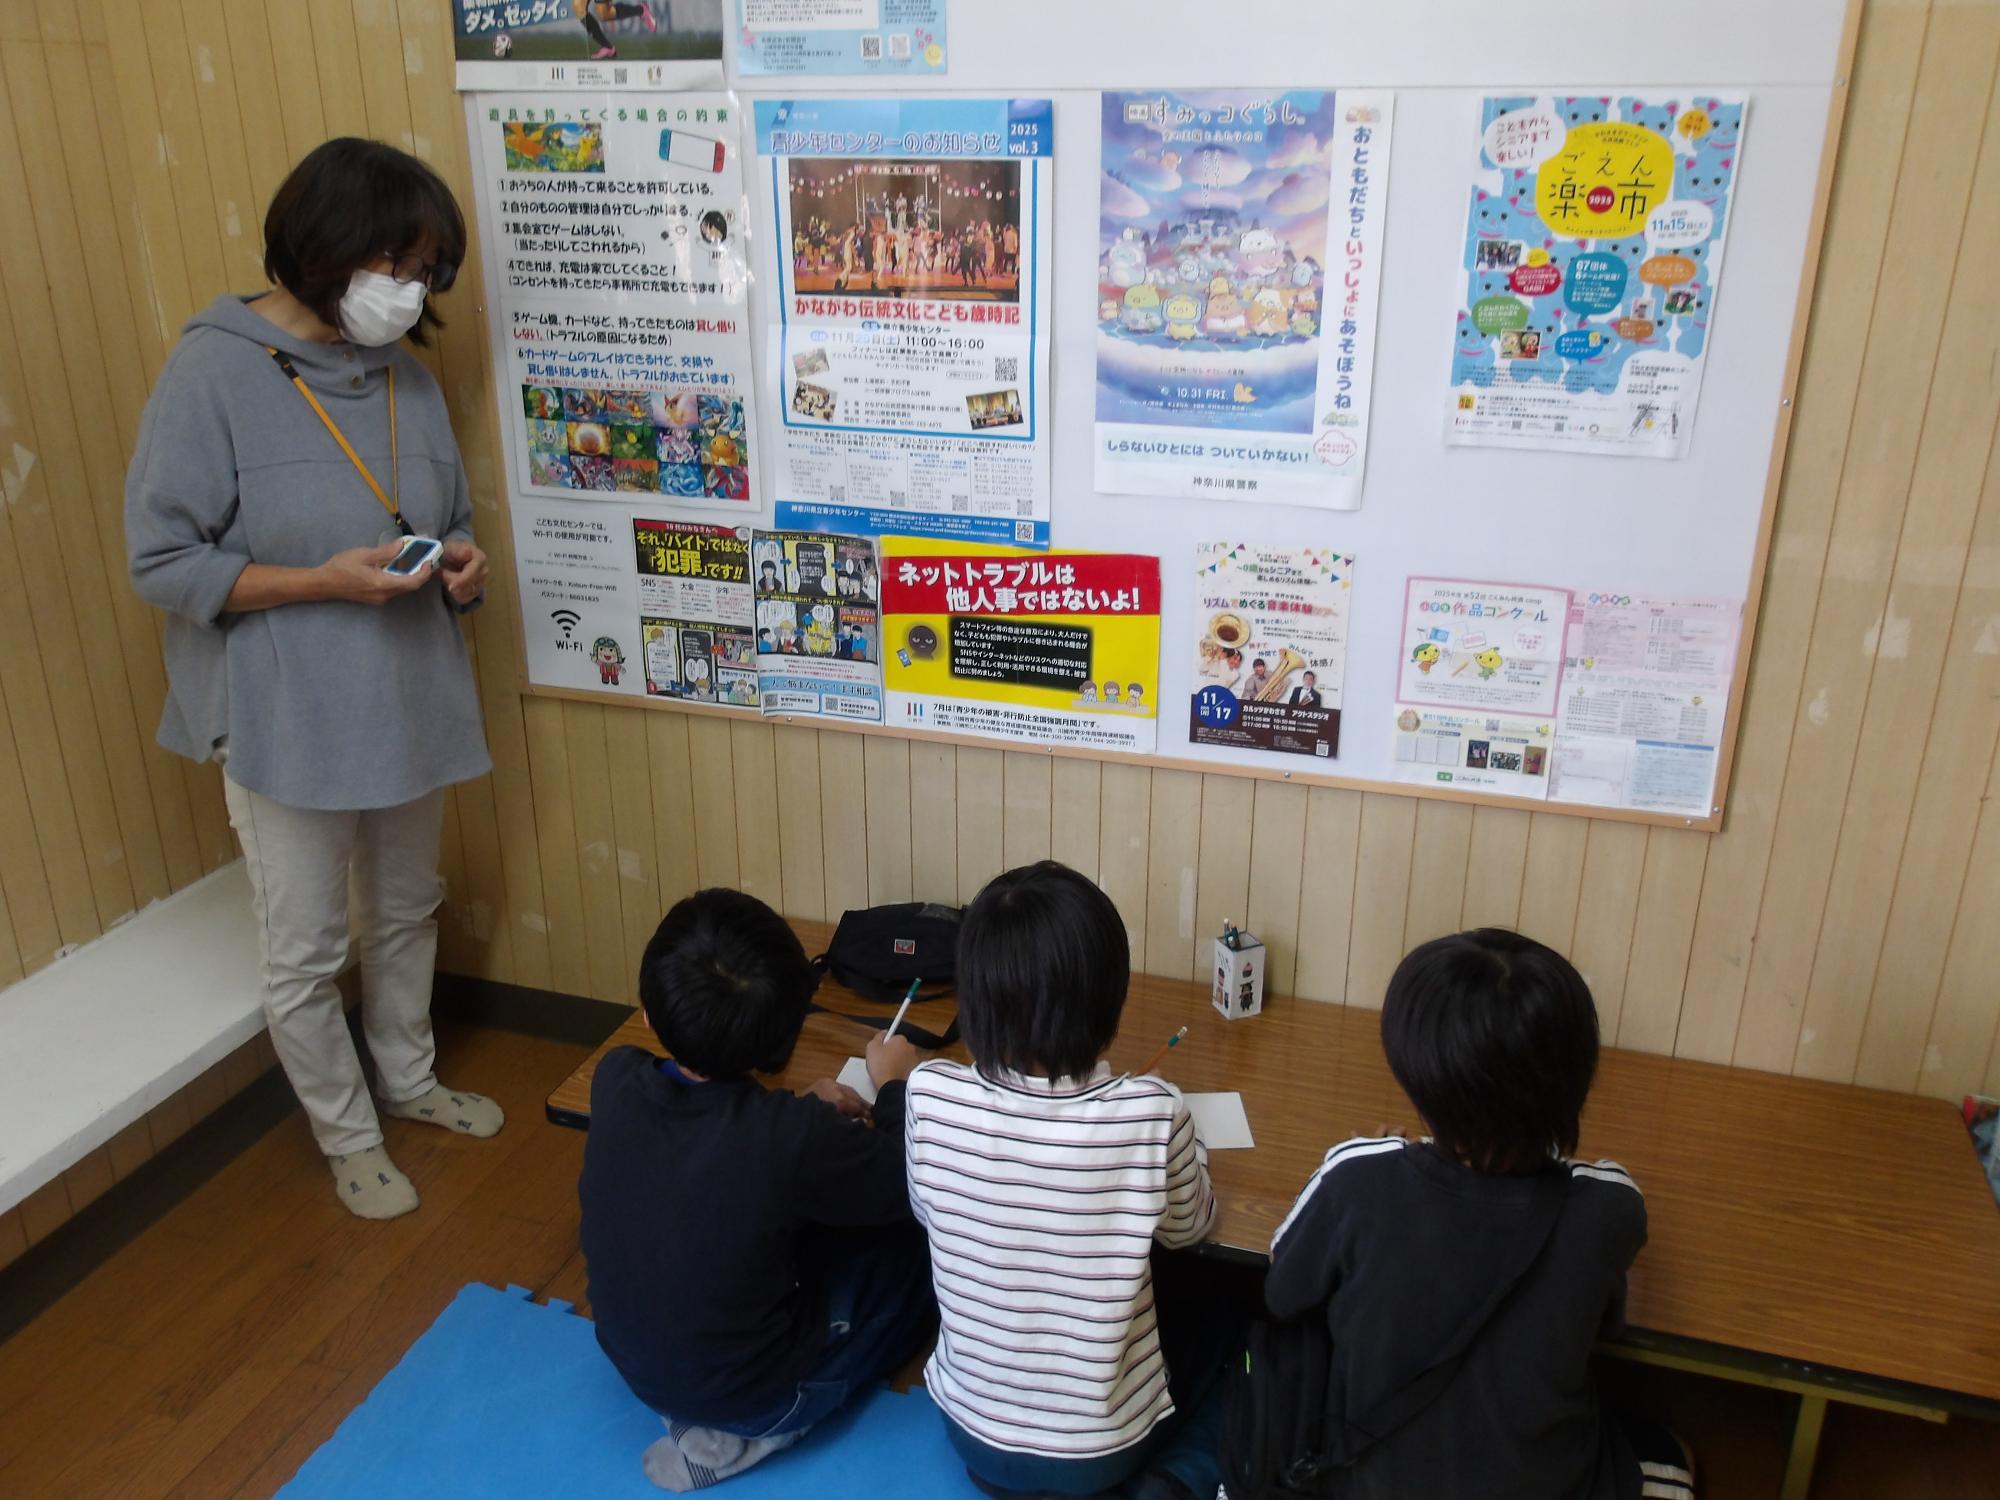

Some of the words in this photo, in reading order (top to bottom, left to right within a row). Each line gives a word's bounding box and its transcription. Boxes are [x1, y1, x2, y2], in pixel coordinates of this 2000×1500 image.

[1010, 123, 1038, 136] 2025
[771, 131, 1001, 152] 青少年センターのお知らせ
[795, 297, 1020, 324] かながわ伝統文化こども歳時記
[1107, 440, 1205, 456] しらないひとには
[1192, 475, 1258, 491] 神奈川県警察
[898, 561, 1076, 588] ネットトラブルは
[641, 579, 657, 588] SNS
[555, 640, 584, 653] Wi-Fi
